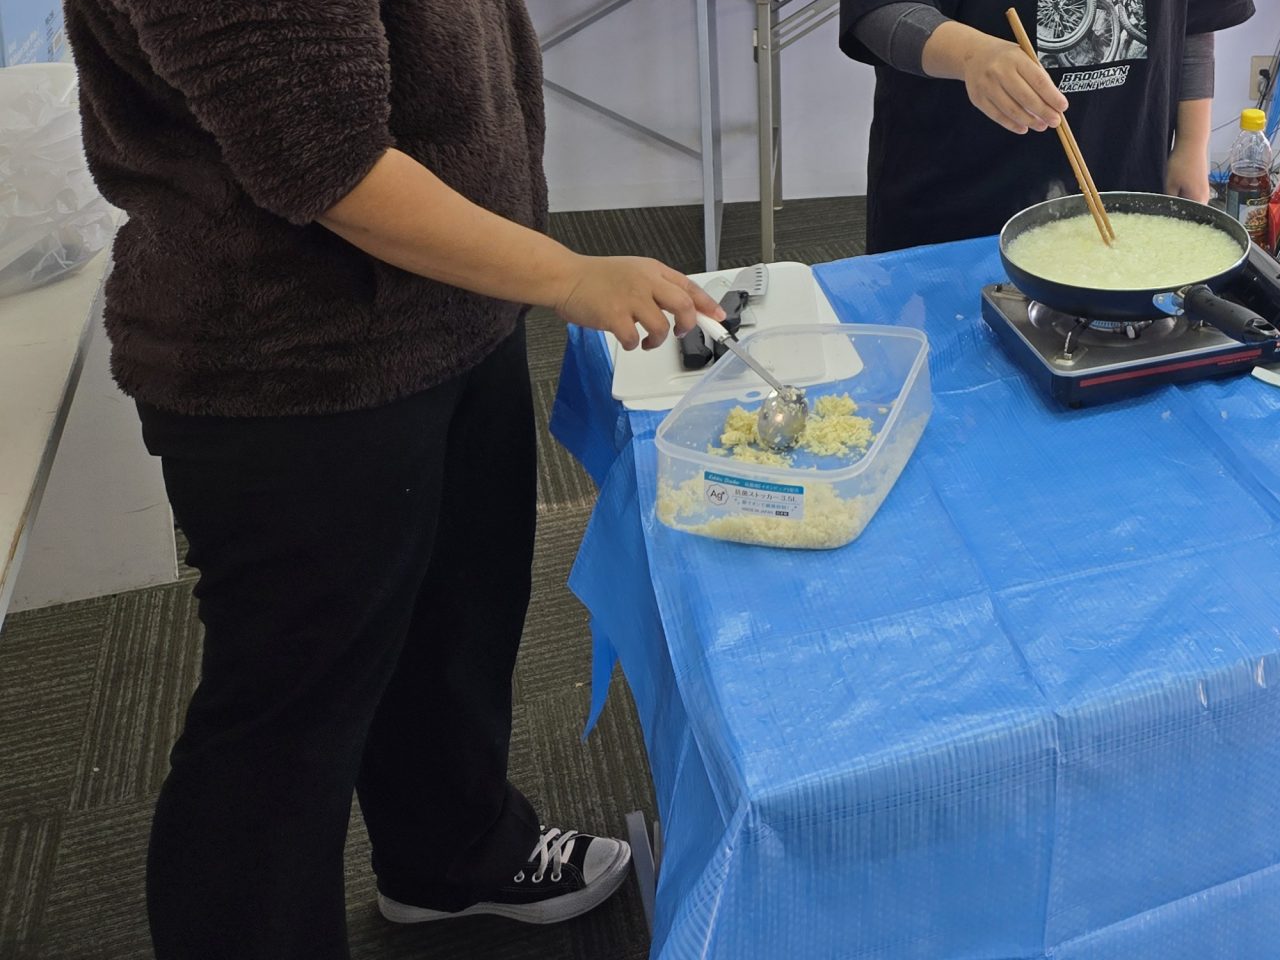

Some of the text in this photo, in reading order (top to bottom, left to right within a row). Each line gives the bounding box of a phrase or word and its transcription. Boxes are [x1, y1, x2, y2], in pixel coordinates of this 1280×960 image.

[1063, 65, 1129, 82] BROOKLYN
[1060, 76, 1126, 92] MACHINE WORKS
